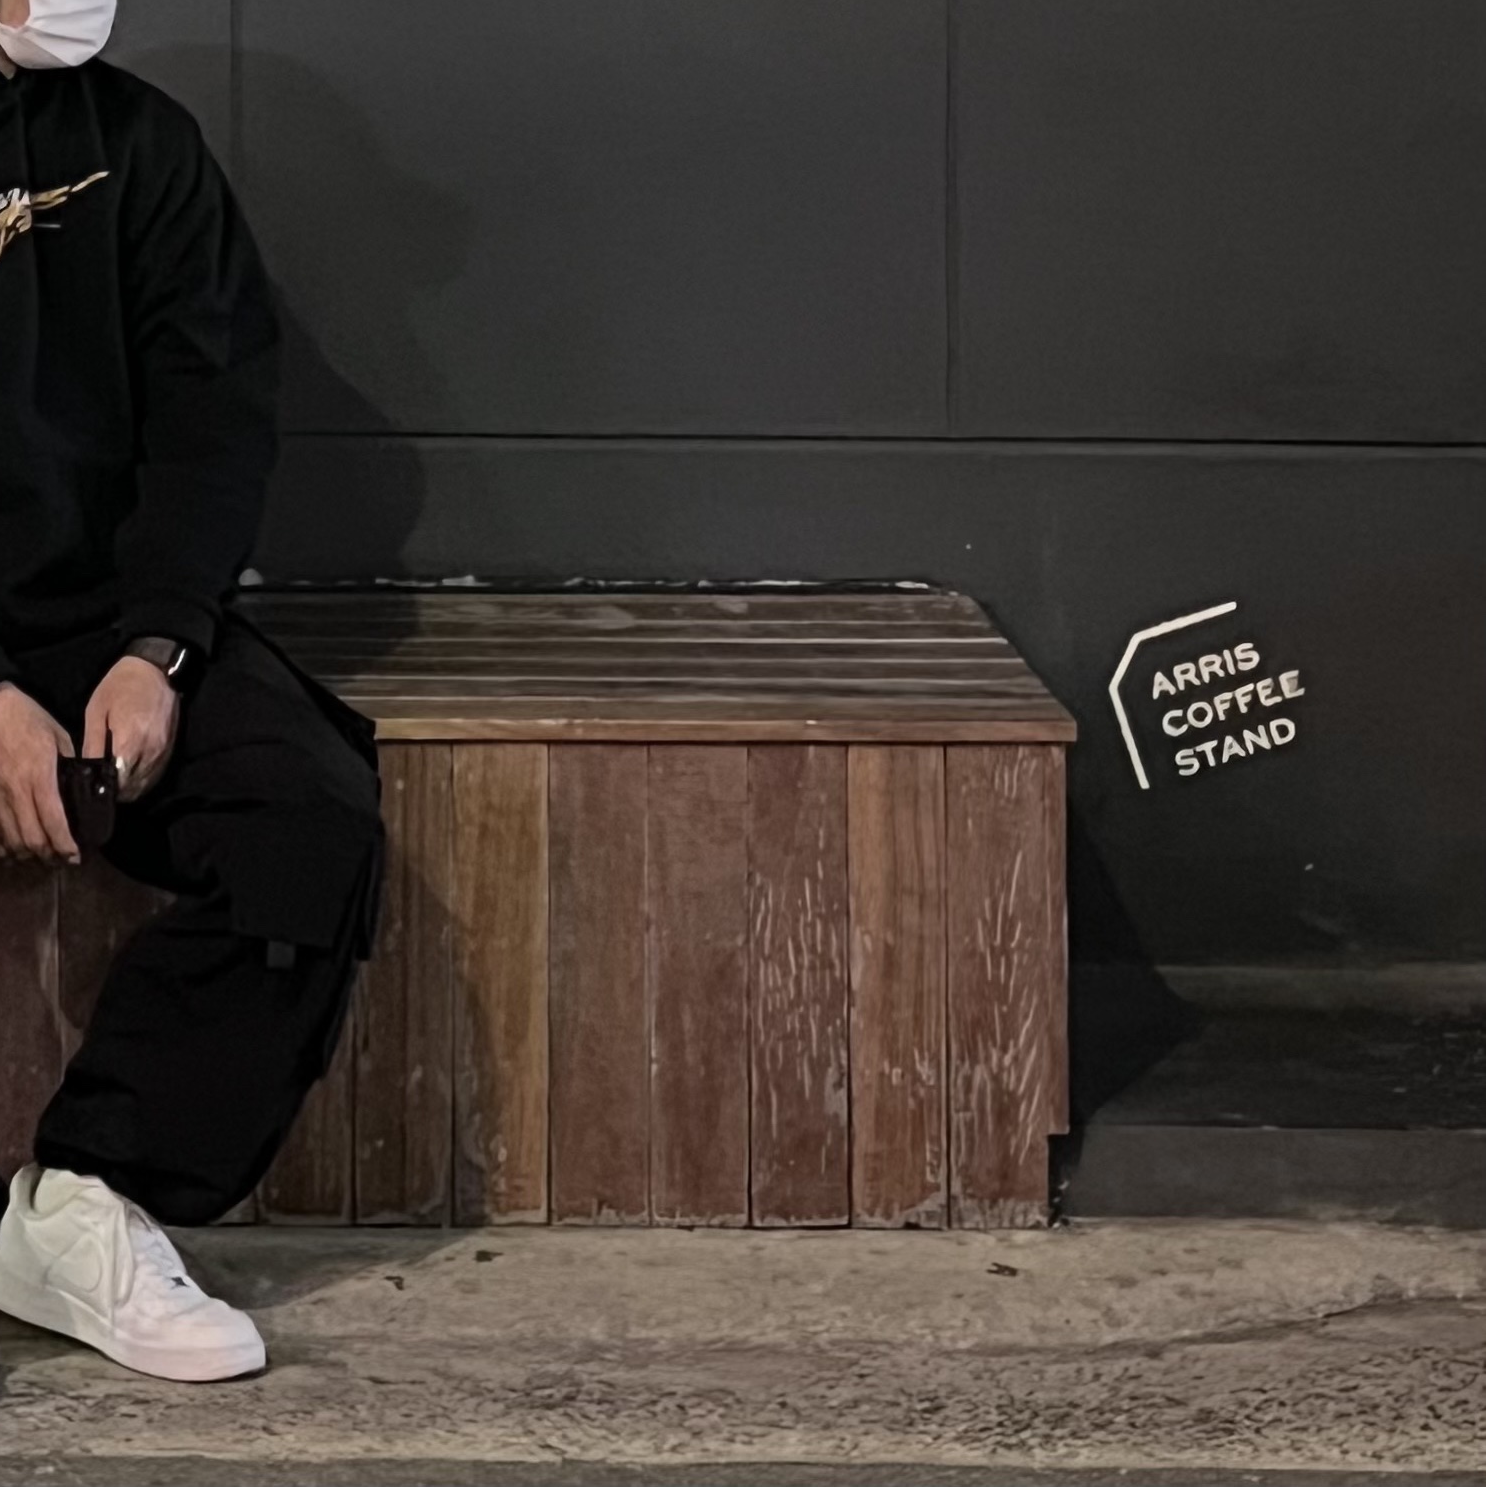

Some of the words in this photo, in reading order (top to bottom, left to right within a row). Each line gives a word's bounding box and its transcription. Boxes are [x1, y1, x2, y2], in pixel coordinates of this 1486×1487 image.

[1152, 642, 1261, 701] ARRIS
[1161, 669, 1307, 738] COFFEE
[1174, 717, 1296, 777] STAND
